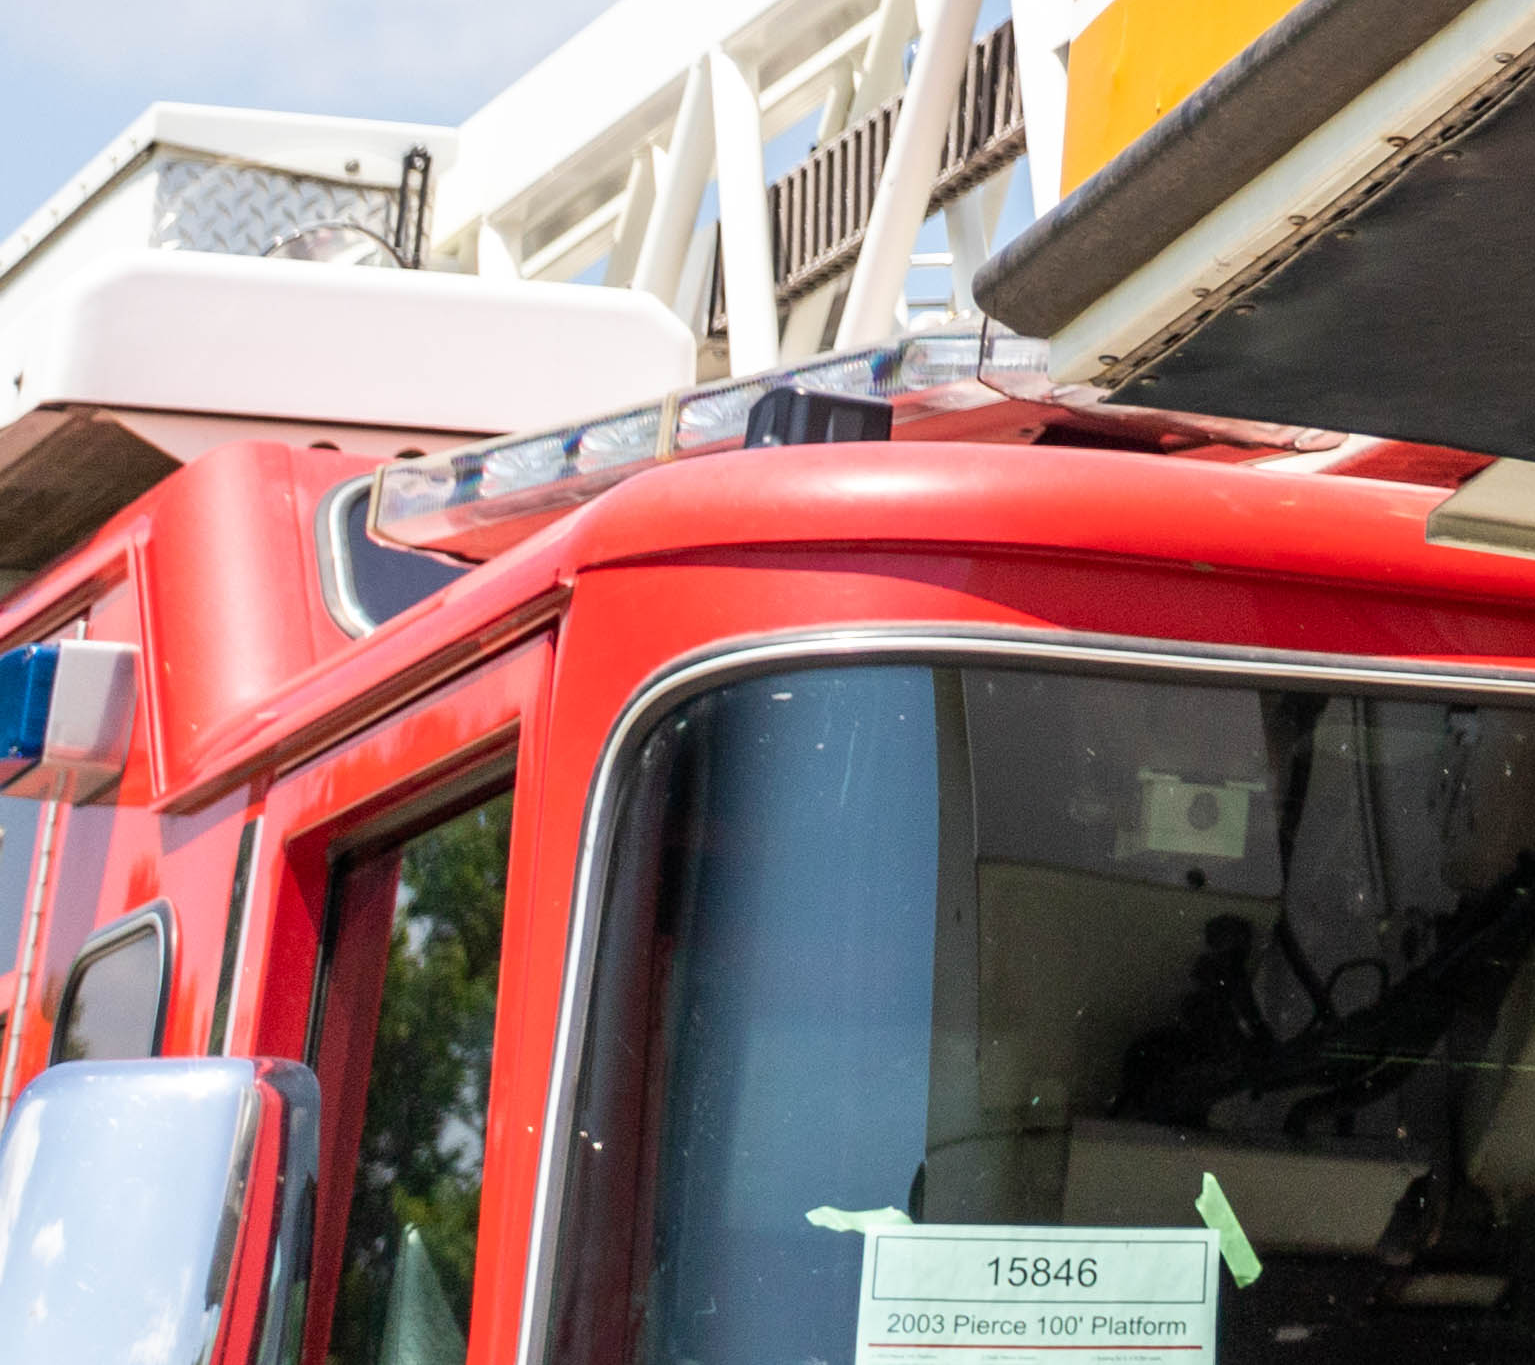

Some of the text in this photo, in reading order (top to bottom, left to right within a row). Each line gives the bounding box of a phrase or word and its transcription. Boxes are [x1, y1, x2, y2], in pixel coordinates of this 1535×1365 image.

[988, 1257, 1097, 1287] 15846
[887, 1314, 1187, 1337] 2003 Pierce 100' Platform
